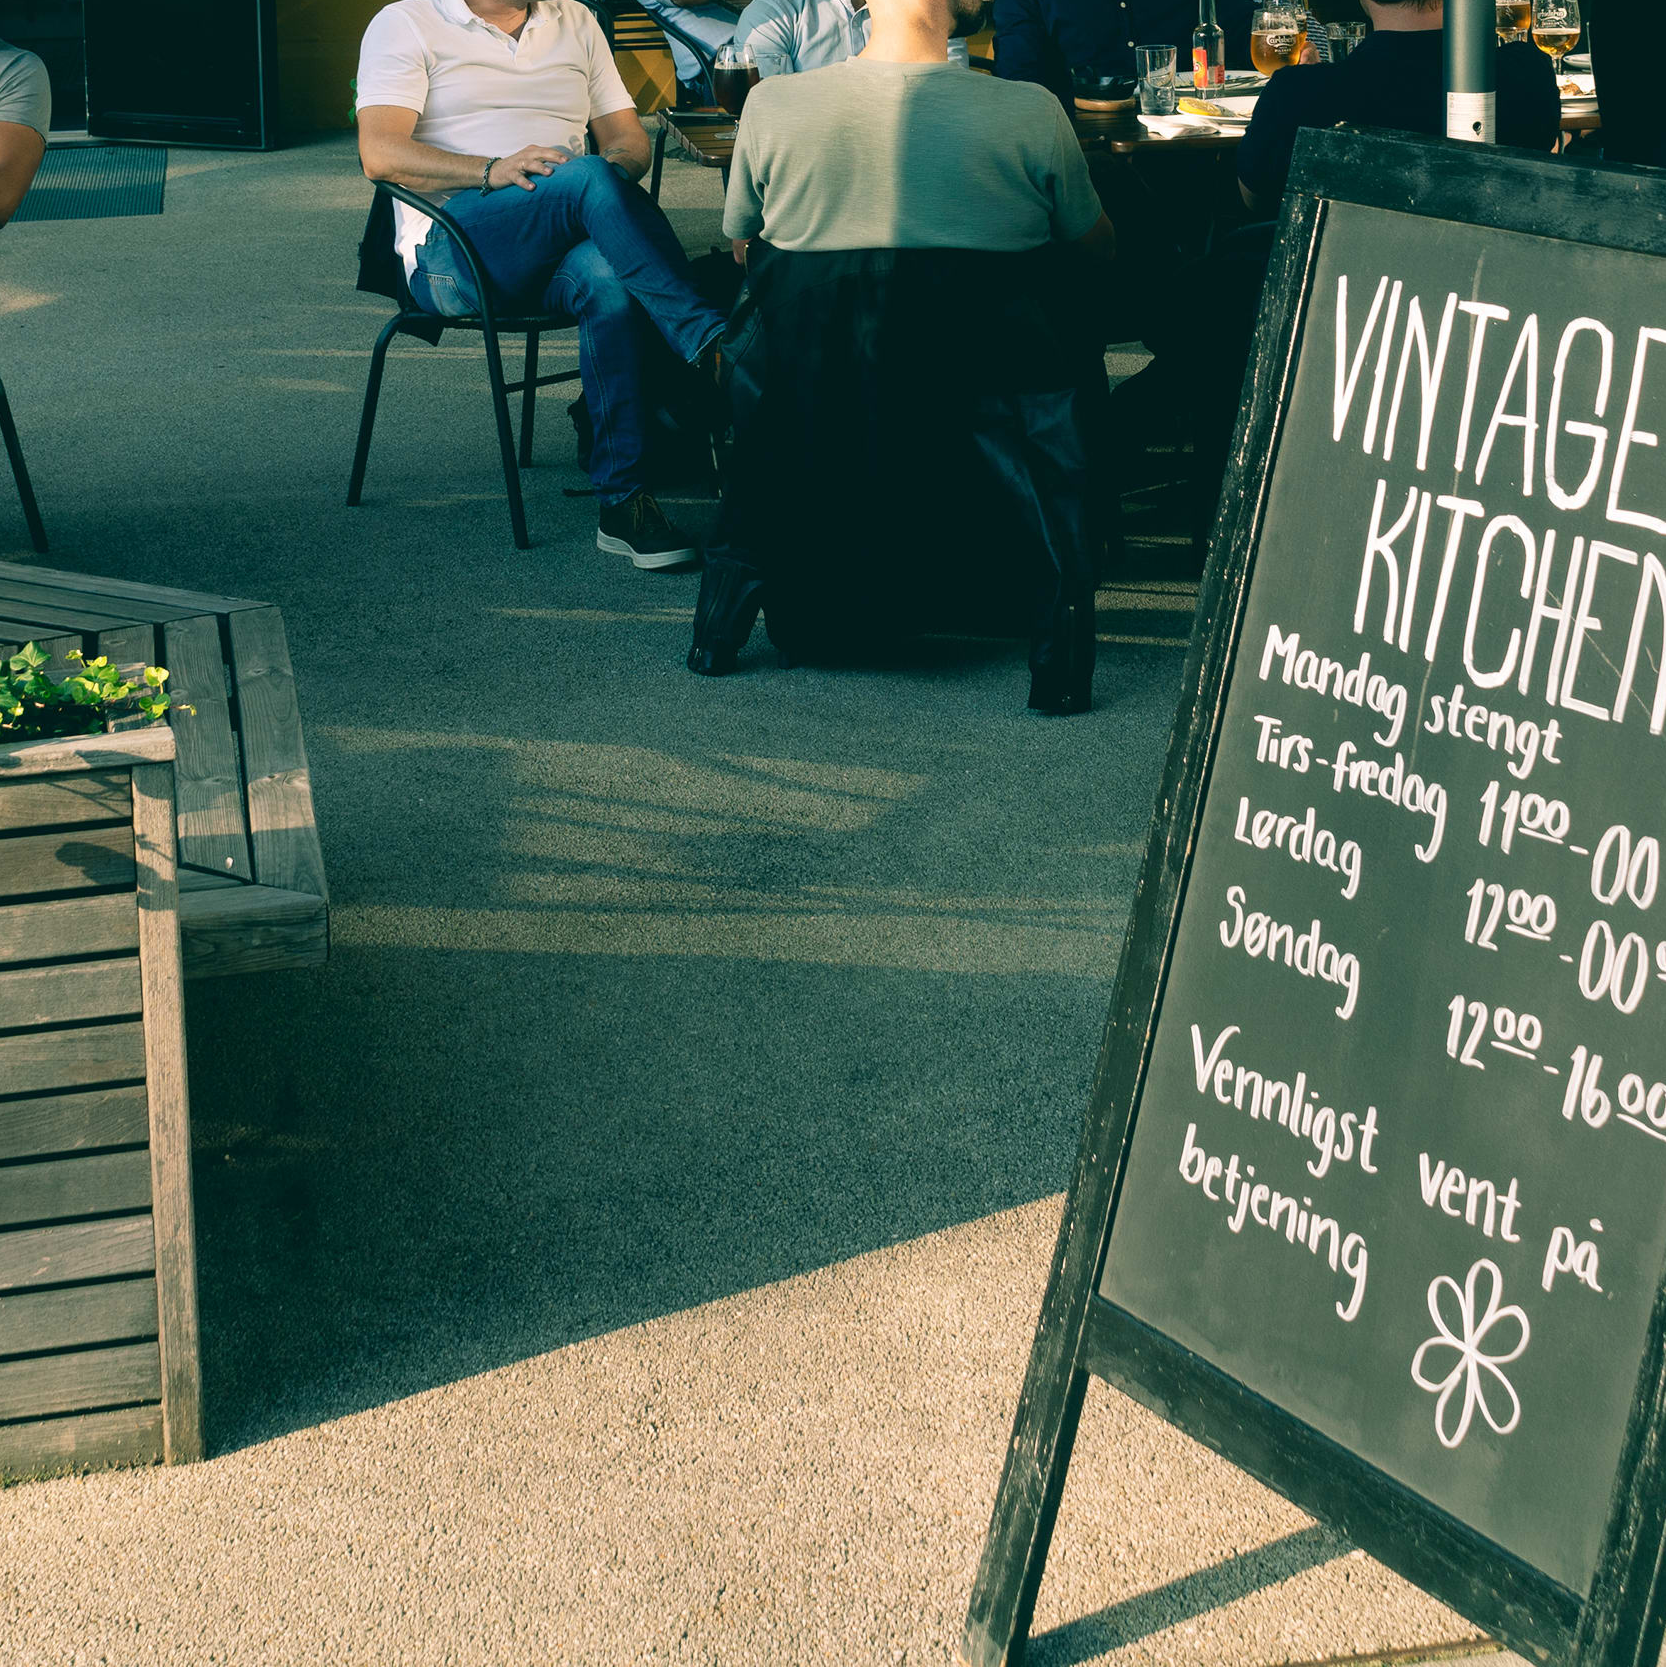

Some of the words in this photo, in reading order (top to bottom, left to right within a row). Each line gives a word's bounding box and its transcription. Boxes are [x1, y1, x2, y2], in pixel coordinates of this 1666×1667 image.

[1258, 624, 1408, 748] Mandag
[1423, 684, 1563, 773] stengt
[1234, 796, 1362, 900] Lørdag
[1254, 714, 1448, 862] Tirs-fredag
[1219, 887, 1360, 1020] Søndag
[1178, 1123, 1368, 1321] betjening
[1190, 1023, 1379, 1179] Vennligst
[1419, 1152, 1522, 1243] vent
[1541, 1218, 1604, 1293] på
